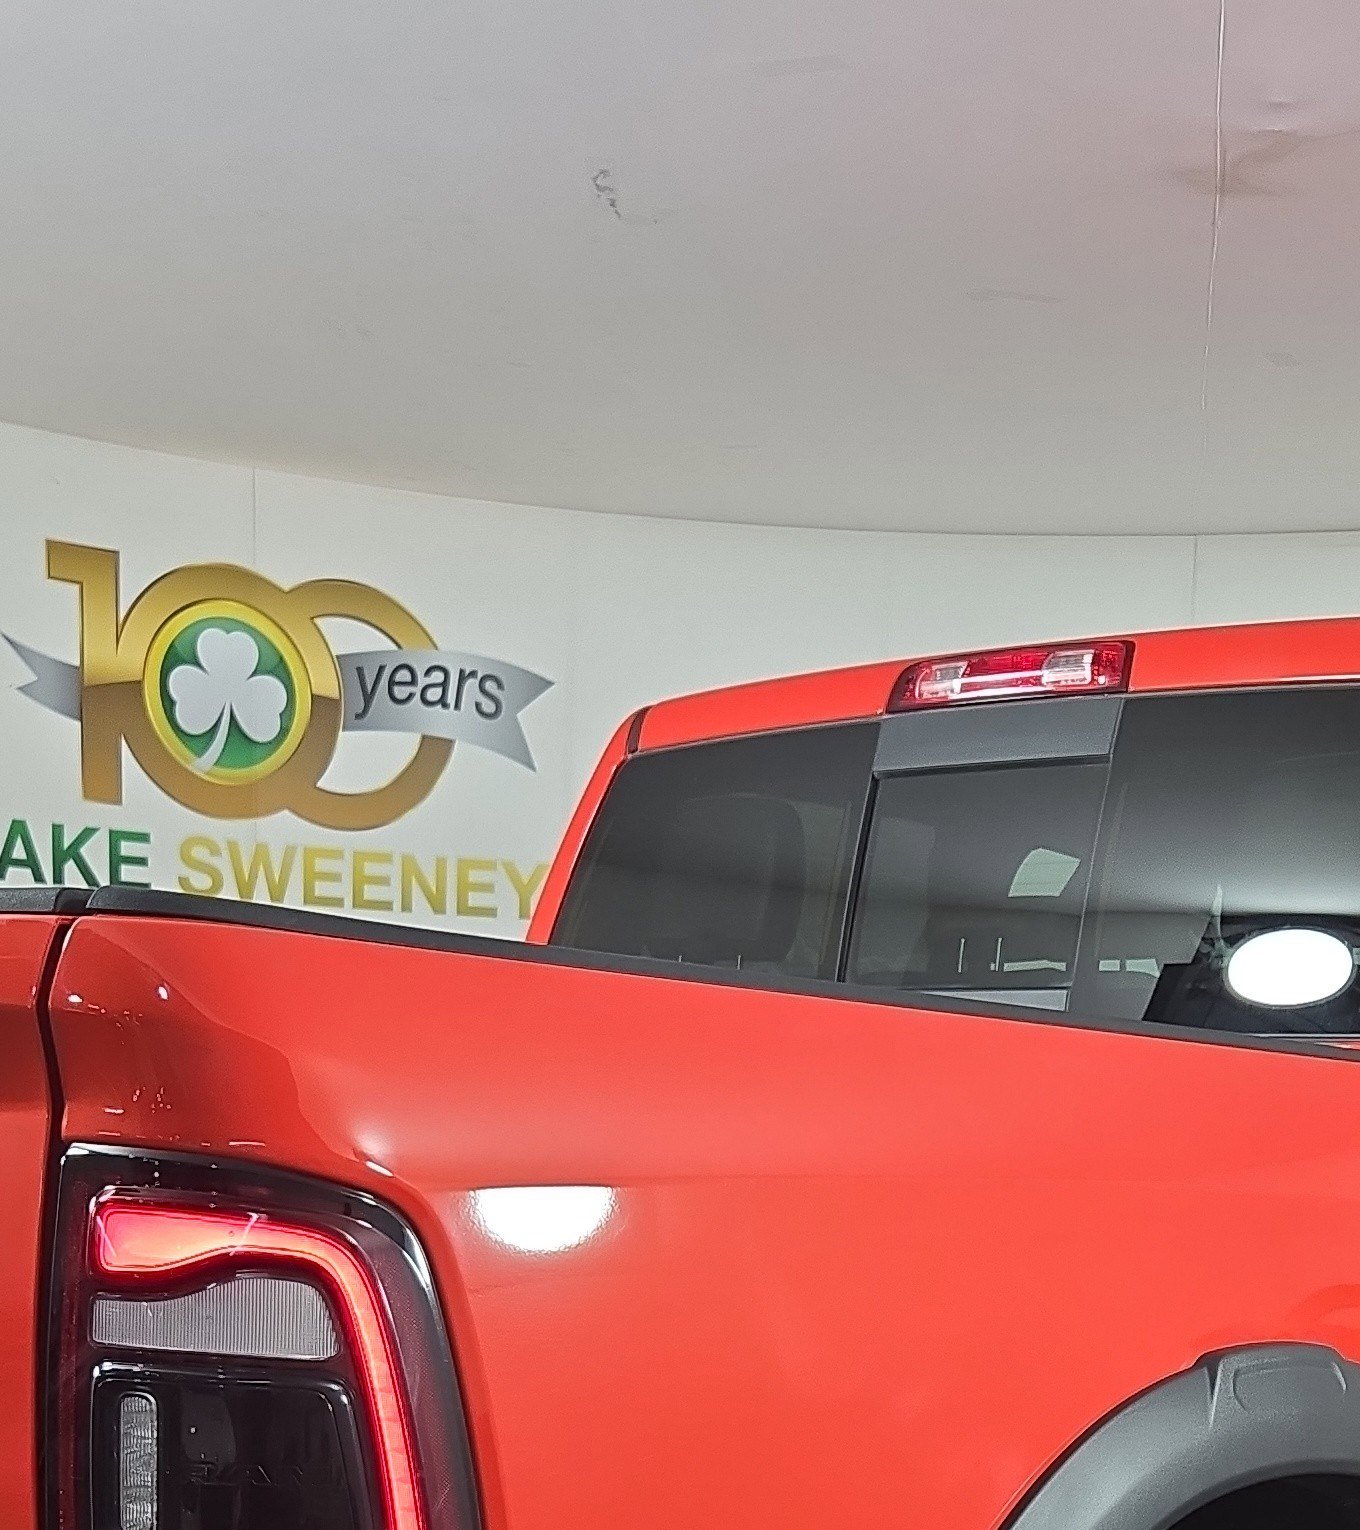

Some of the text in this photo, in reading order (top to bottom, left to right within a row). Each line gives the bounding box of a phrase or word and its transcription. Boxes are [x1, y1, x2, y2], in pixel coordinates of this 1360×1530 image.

[45, 538, 456, 832] 100
[354, 659, 506, 721] years
[177, 834, 551, 920] SWEENEY
